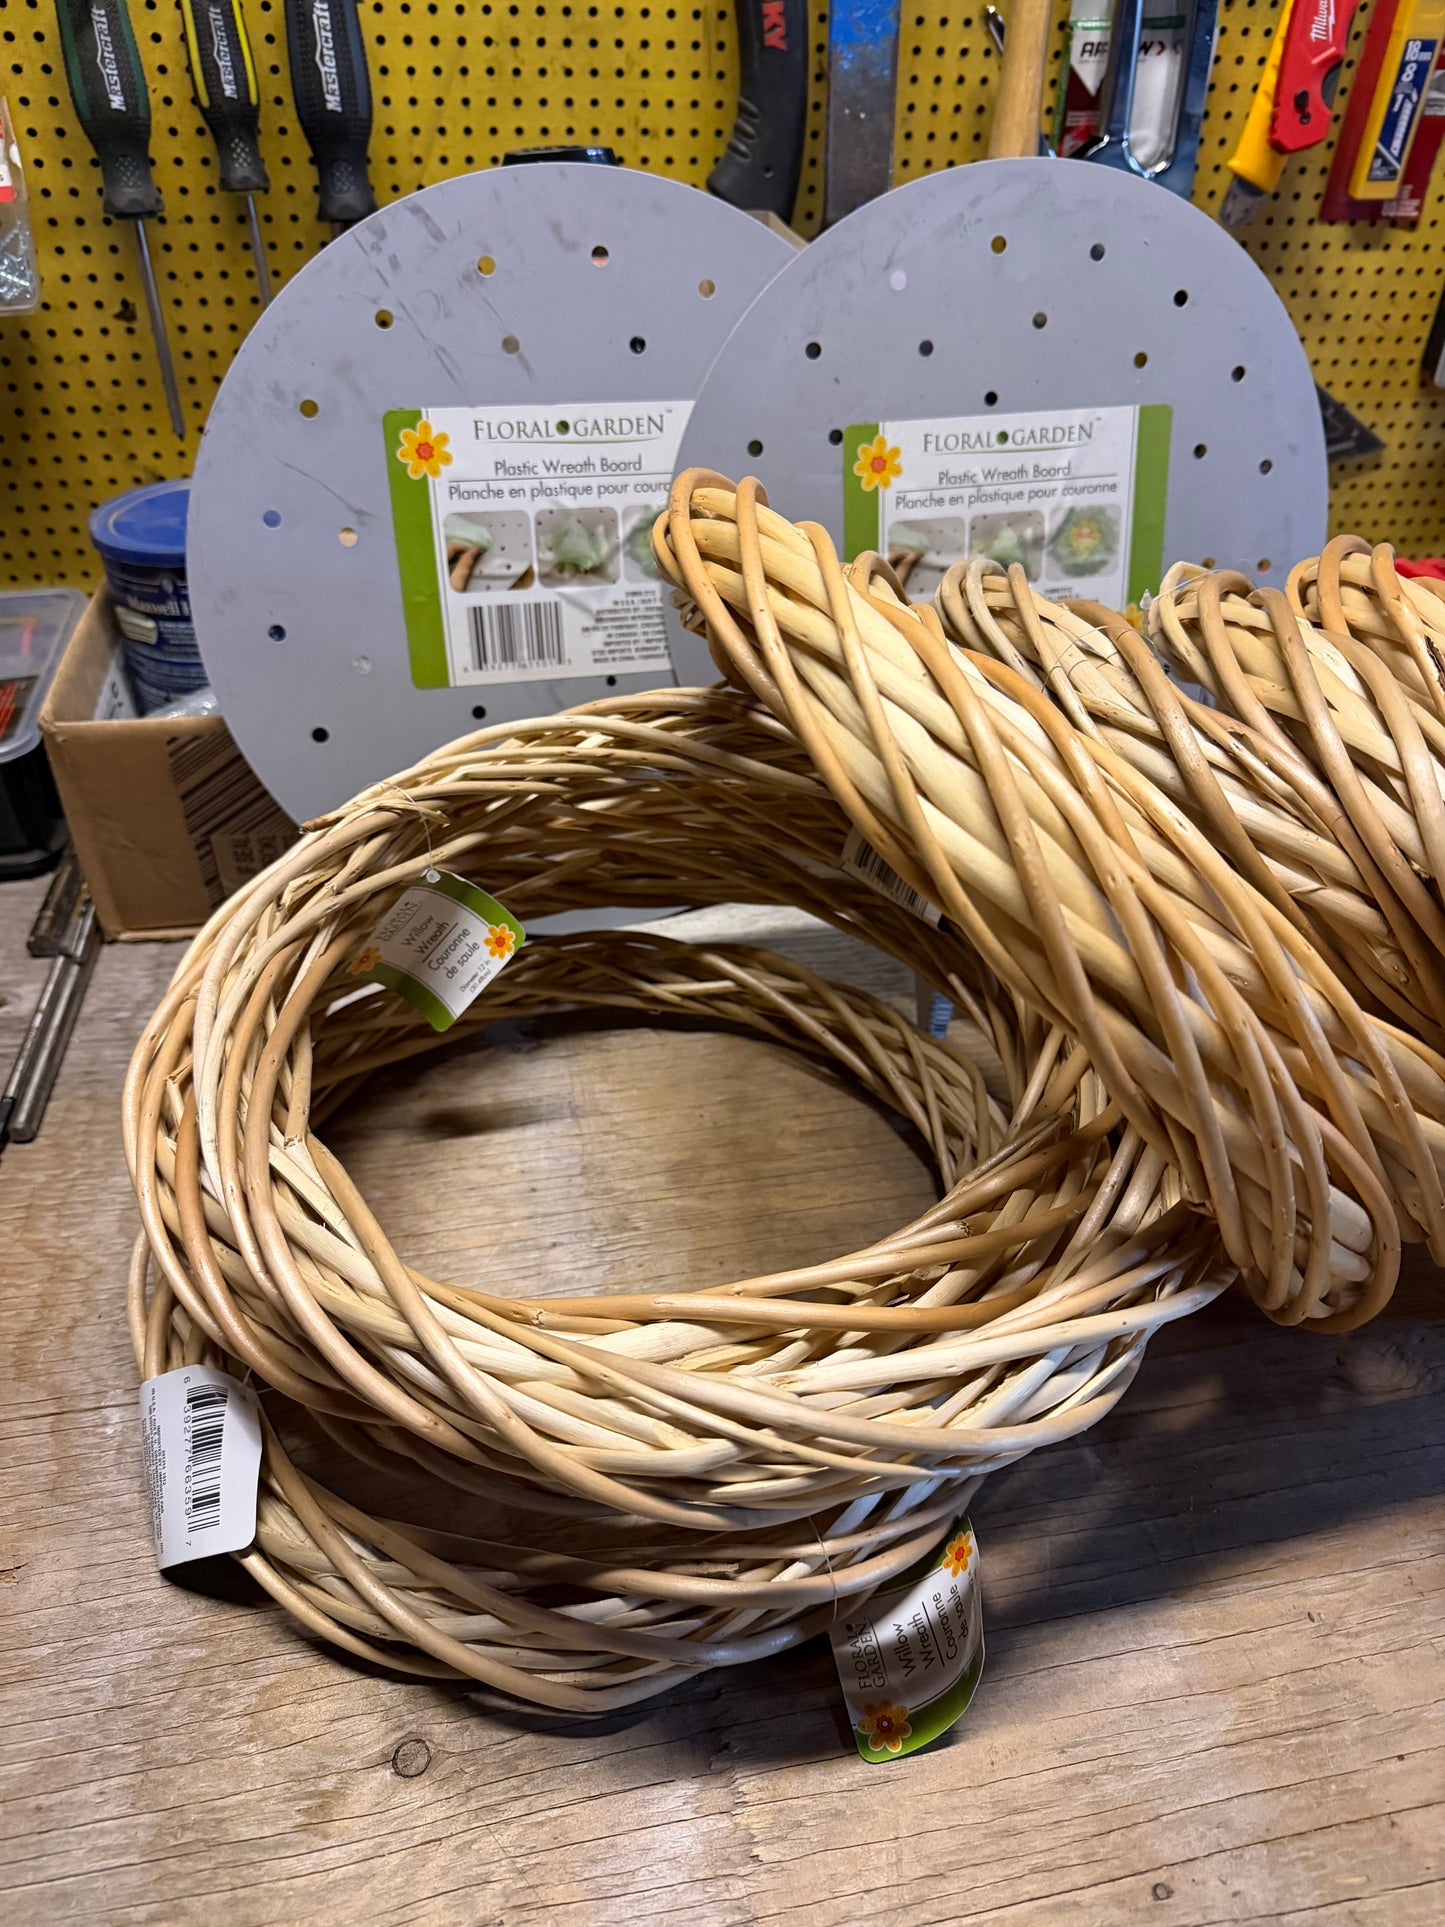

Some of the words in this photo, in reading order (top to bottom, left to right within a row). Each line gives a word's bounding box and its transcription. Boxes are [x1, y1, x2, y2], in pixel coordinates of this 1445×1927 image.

[1310, 0, 1332, 42] Milwa
[91, 4, 127, 112] Mastercraft
[208, 6, 239, 99] Mastercraft
[312, 0, 343, 113] Mastercraft
[473, 419, 554, 441] FLORAL
[573, 414, 666, 438] GARDEN
[923, 432, 994, 452] FLORAL
[1010, 422, 1093, 446] GARDEN
[494, 459, 539, 477] Plastic
[543, 457, 597, 474] Wreath
[601, 455, 643, 472] Board
[938, 468, 977, 486] Plastic
[981, 465, 1029, 482] Wreath
[1032, 461, 1071, 477] Board
[449, 483, 505, 501] Planche
[509, 487, 526, 497] en
[531, 482, 593, 500] plastique
[597, 484, 629, 499] pour
[633, 483, 671, 493] couro
[895, 491, 945, 510] Planche
[949, 495, 965, 505] en
[968, 488, 1024, 508] plastique
[1027, 486, 1058, 503] pour
[1061, 481, 1118, 497] couronne
[401, 914, 435, 947] Willow
[415, 921, 450, 956] Wreath
[427, 927, 471, 972] Couronne
[445, 962, 459, 980] de
[457, 940, 481, 967] saule
[184, 1376, 191, 1384] 6
[184, 1405, 192, 1454] 39277
[947, 1584, 964, 1619] saule
[908, 1612, 936, 1670] Wreath
[932, 1591, 958, 1660] Couronne
[957, 1620, 969, 1639] de
[846, 1631, 873, 1690] FLORAL
[859, 1622, 886, 1688] GARDEN
[892, 1623, 916, 1677] Willow
